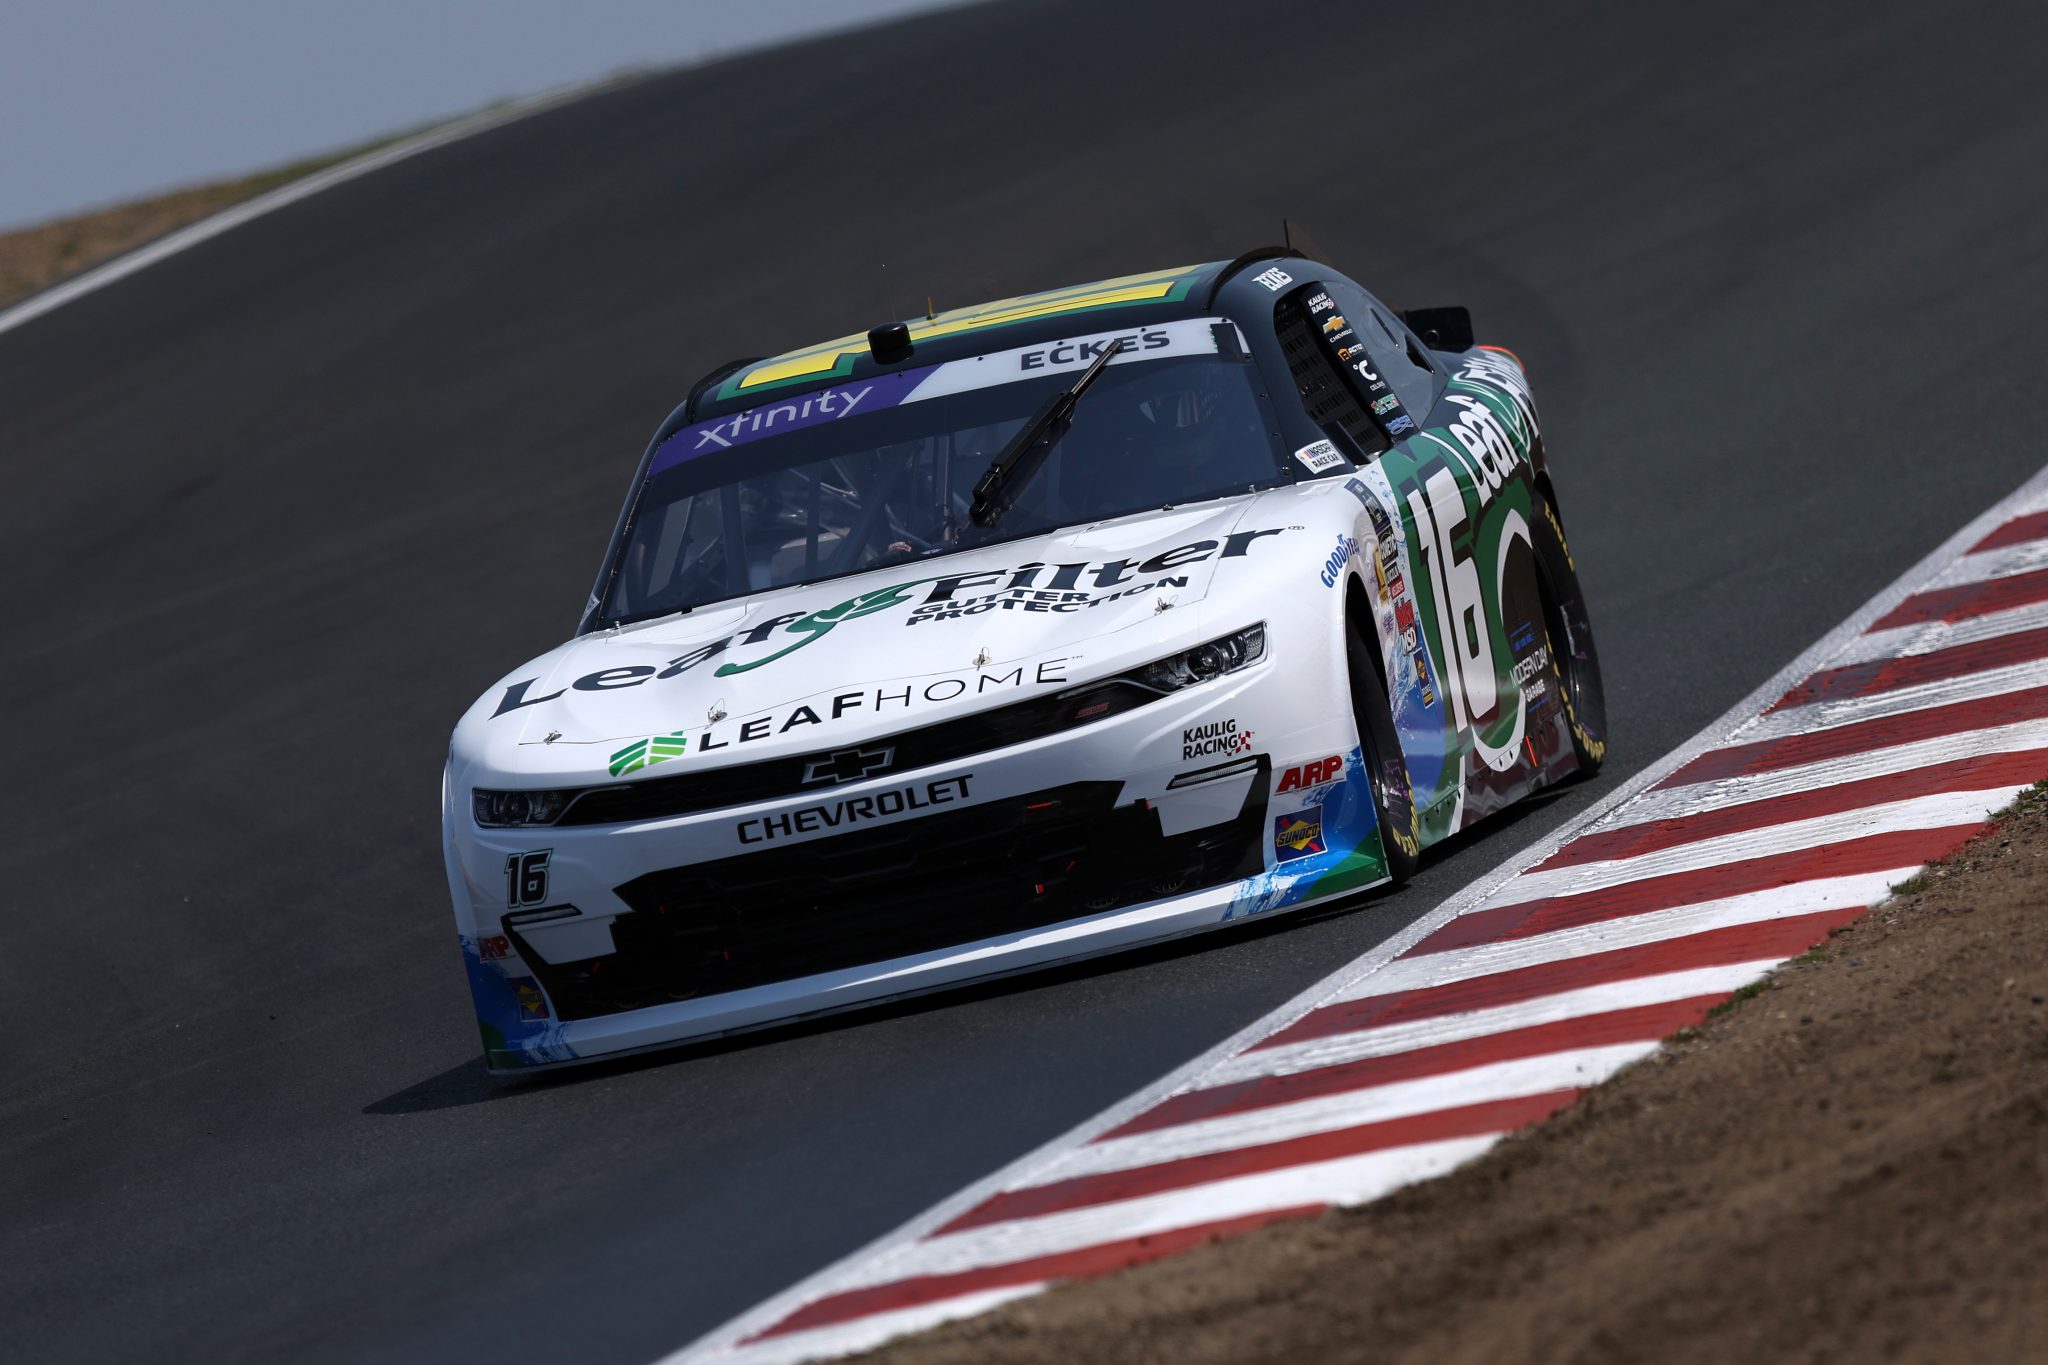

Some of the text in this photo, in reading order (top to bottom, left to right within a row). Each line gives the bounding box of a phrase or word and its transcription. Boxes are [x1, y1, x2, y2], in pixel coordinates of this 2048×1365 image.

[1021, 331, 1170, 371] ECKES
[694, 386, 873, 449] xfinity
[1312, 456, 1330, 468] RACE
[905, 576, 1188, 627] PROTECTION
[912, 589, 1089, 615] GUTTER
[1406, 466, 1497, 734] 16
[1182, 734, 1239, 761] RACING
[1183, 718, 1236, 744] KAULIG
[1275, 755, 1343, 793] ARP
[737, 774, 974, 845] CHEVROLET
[1276, 824, 1319, 846] SUNOCO
[504, 847, 554, 909] 16
